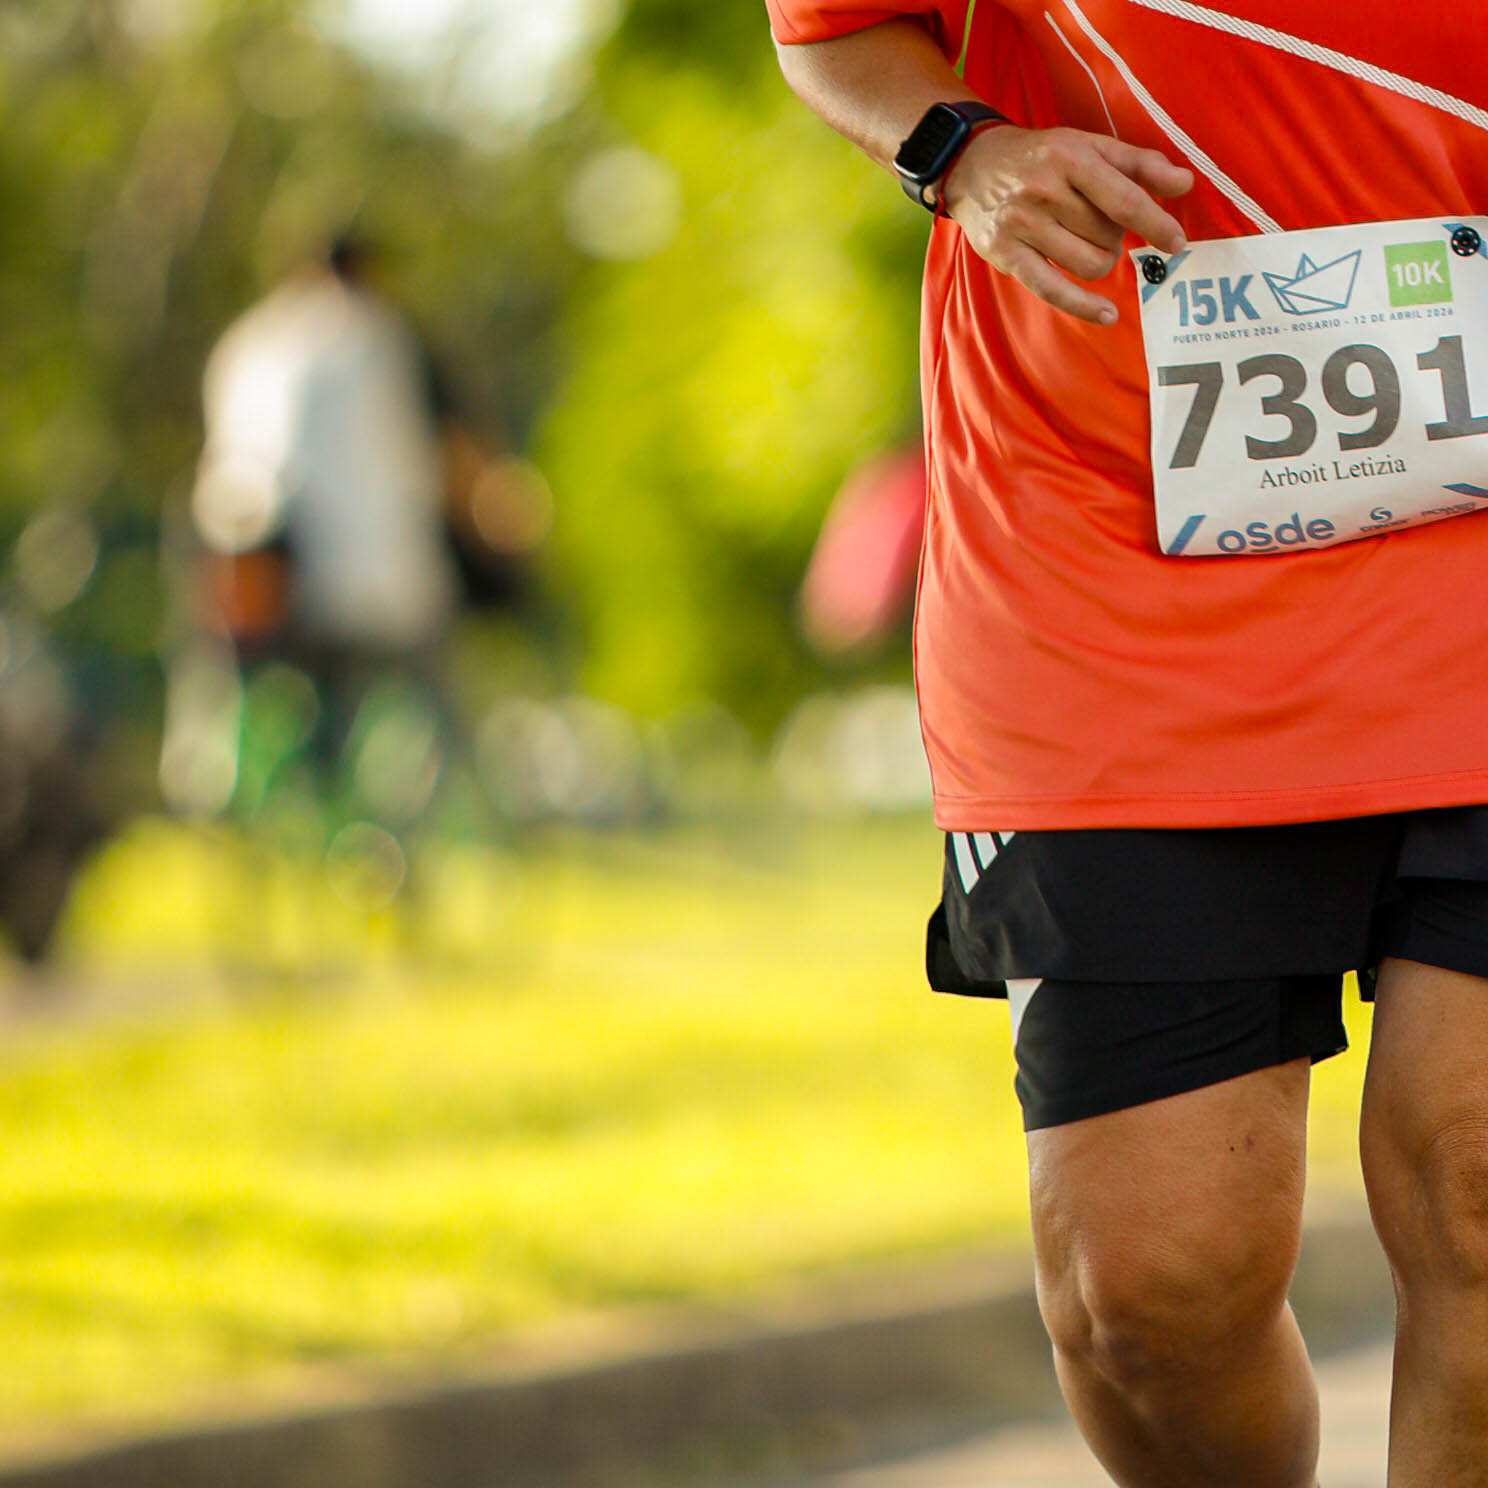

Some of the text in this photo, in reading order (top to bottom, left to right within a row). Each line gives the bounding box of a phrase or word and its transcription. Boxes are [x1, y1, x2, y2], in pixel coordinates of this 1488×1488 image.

[1391, 258, 1446, 288] 10K
[1171, 274, 1261, 327] 15K
[1173, 333, 1212, 344] PUERTO
[1215, 328, 1250, 341] NORTE
[1291, 318, 1340, 332] ROSARIO
[1353, 315, 1367, 325] 12
[1370, 313, 1385, 323] DE
[1389, 310, 1422, 321] ABRIL
[1260, 454, 1407, 489] Arboit Letizia
[1217, 511, 1336, 553] osde
